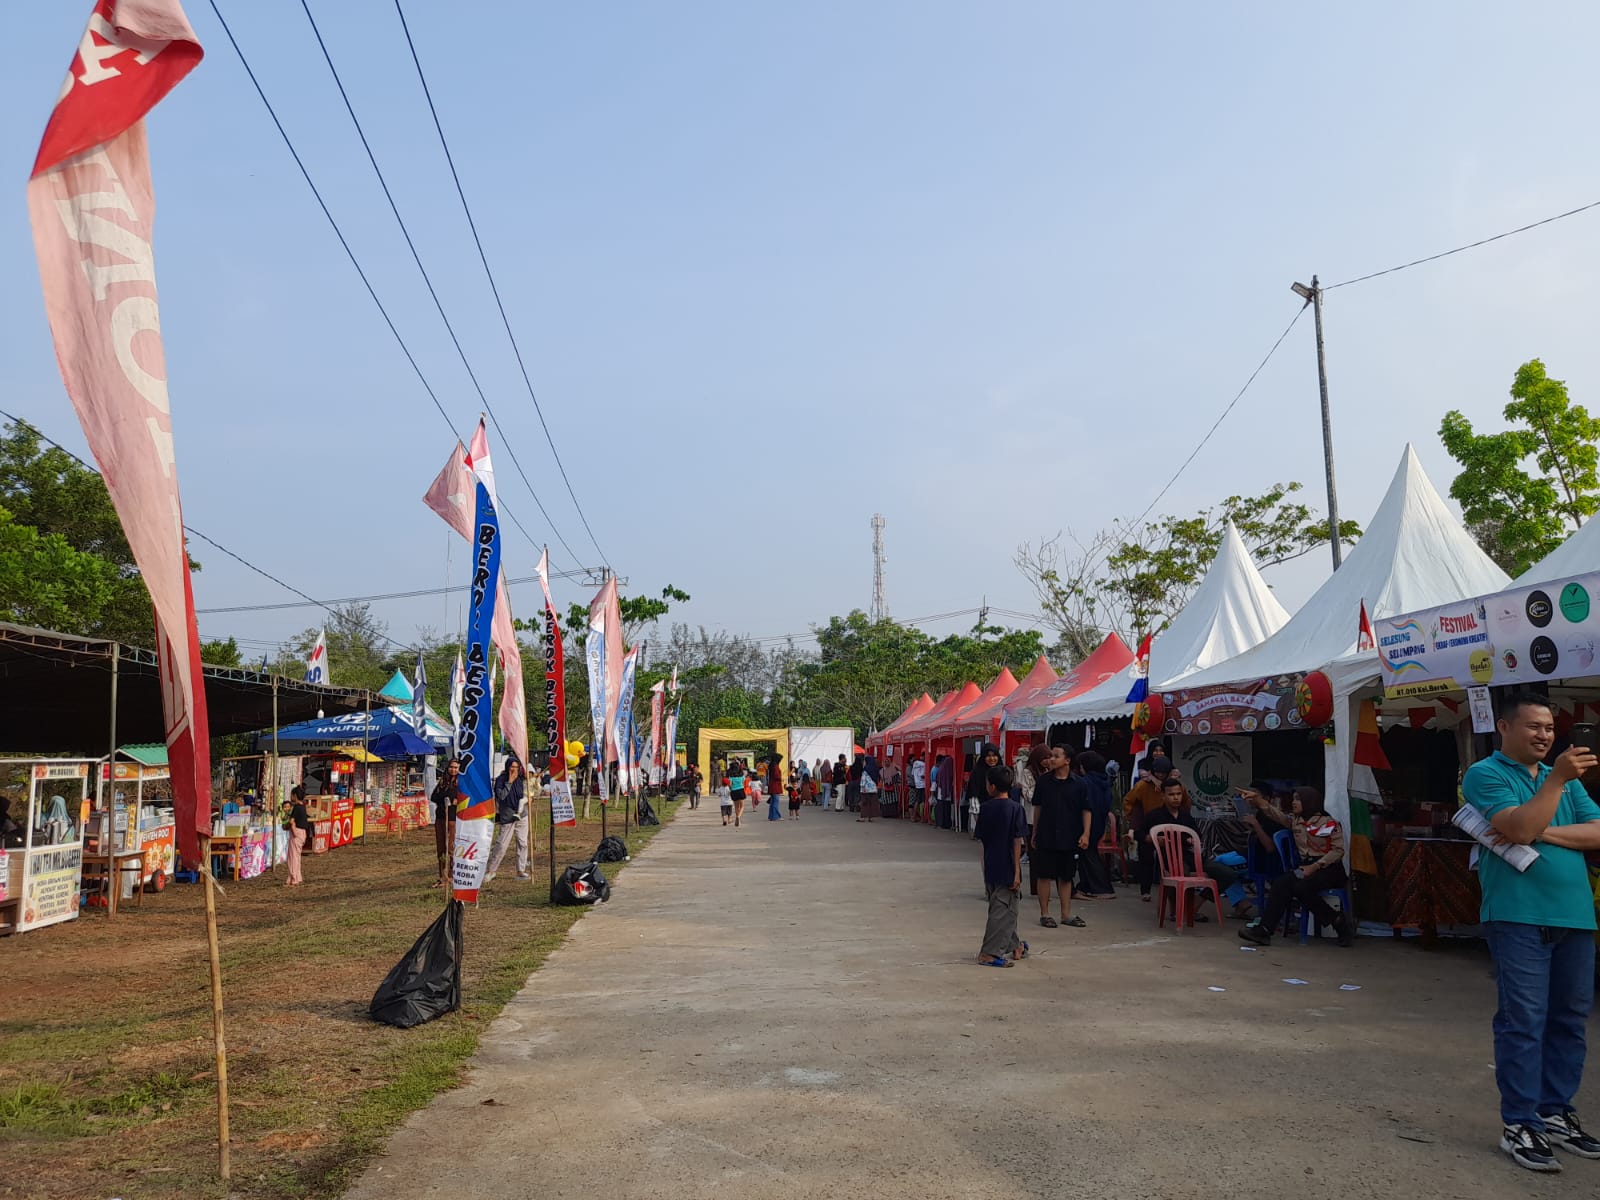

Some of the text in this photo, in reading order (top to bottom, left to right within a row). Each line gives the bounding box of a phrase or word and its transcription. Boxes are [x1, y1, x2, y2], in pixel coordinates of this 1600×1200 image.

[1439, 612, 1478, 634] FESTIVAL
[1380, 631, 1411, 647] SELESUNG
[316, 724, 380, 735] HYUNDAI
[301, 739, 344, 748] HYUNDAI
[456, 862, 480, 872] BEROK
[456, 871, 476, 880] KOBA
